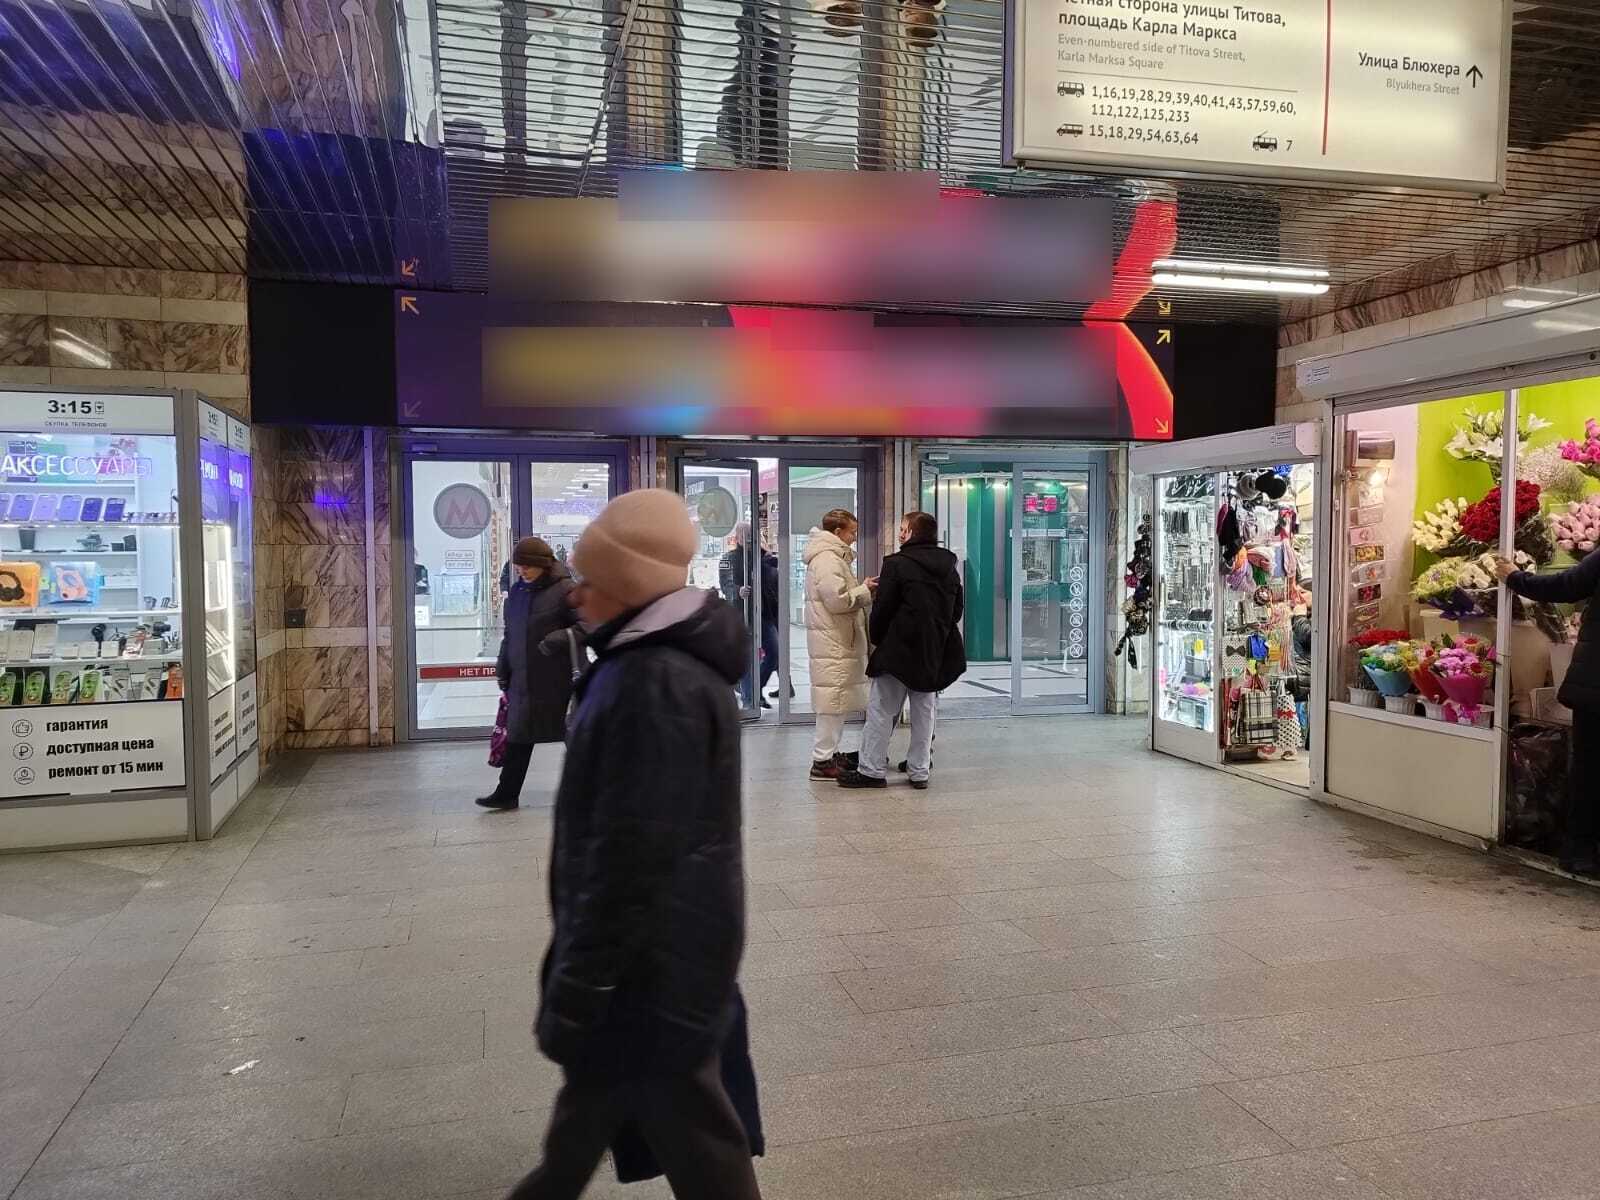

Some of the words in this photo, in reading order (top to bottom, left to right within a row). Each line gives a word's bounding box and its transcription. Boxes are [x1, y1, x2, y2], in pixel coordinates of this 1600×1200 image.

[1118, 0, 1178, 14] сторона
[1183, 4, 1229, 20] улицы
[1233, 6, 1286, 27] Титова,
[1058, 12, 1128, 31] площадь
[1132, 17, 1178, 37] Карла
[1183, 21, 1237, 42] Маркса
[1057, 33, 1140, 52] Even-numbered
[1142, 39, 1164, 53] side
[1166, 44, 1177, 55] of
[1179, 44, 1210, 58] Titova
[1213, 47, 1246, 62] Street,
[1057, 49, 1086, 63] Karla
[1088, 53, 1126, 67] Marksa
[1128, 56, 1164, 71] Square
[1358, 51, 1399, 71] Улица
[1402, 56, 1460, 77] Блюхера
[1386, 77, 1431, 93] Blyukhera
[1433, 82, 1460, 95] Street
[1092, 85, 1297, 115] 1,16,19,28,29,39,40,41,43,57,59,60,
[1091, 103, 1191, 123] 112,122,125,233
[1089, 124, 1200, 145] 15,18,29,54,63,64
[1286, 139, 1293, 151] 7
[48, 399, 92, 414] 3:15
[0, 453, 153, 477] АКСЕССУАРЫ
[459, 667, 481, 677] НЕТ
[483, 666, 497, 676] ПР
[46, 718, 109, 733] гарантия
[46, 740, 119, 756] доступная
[121, 738, 155, 753] цена
[48, 764, 99, 779] ремонт
[102, 763, 116, 775] от
[119, 762, 134, 774] 15
[136, 760, 164, 773] мин
